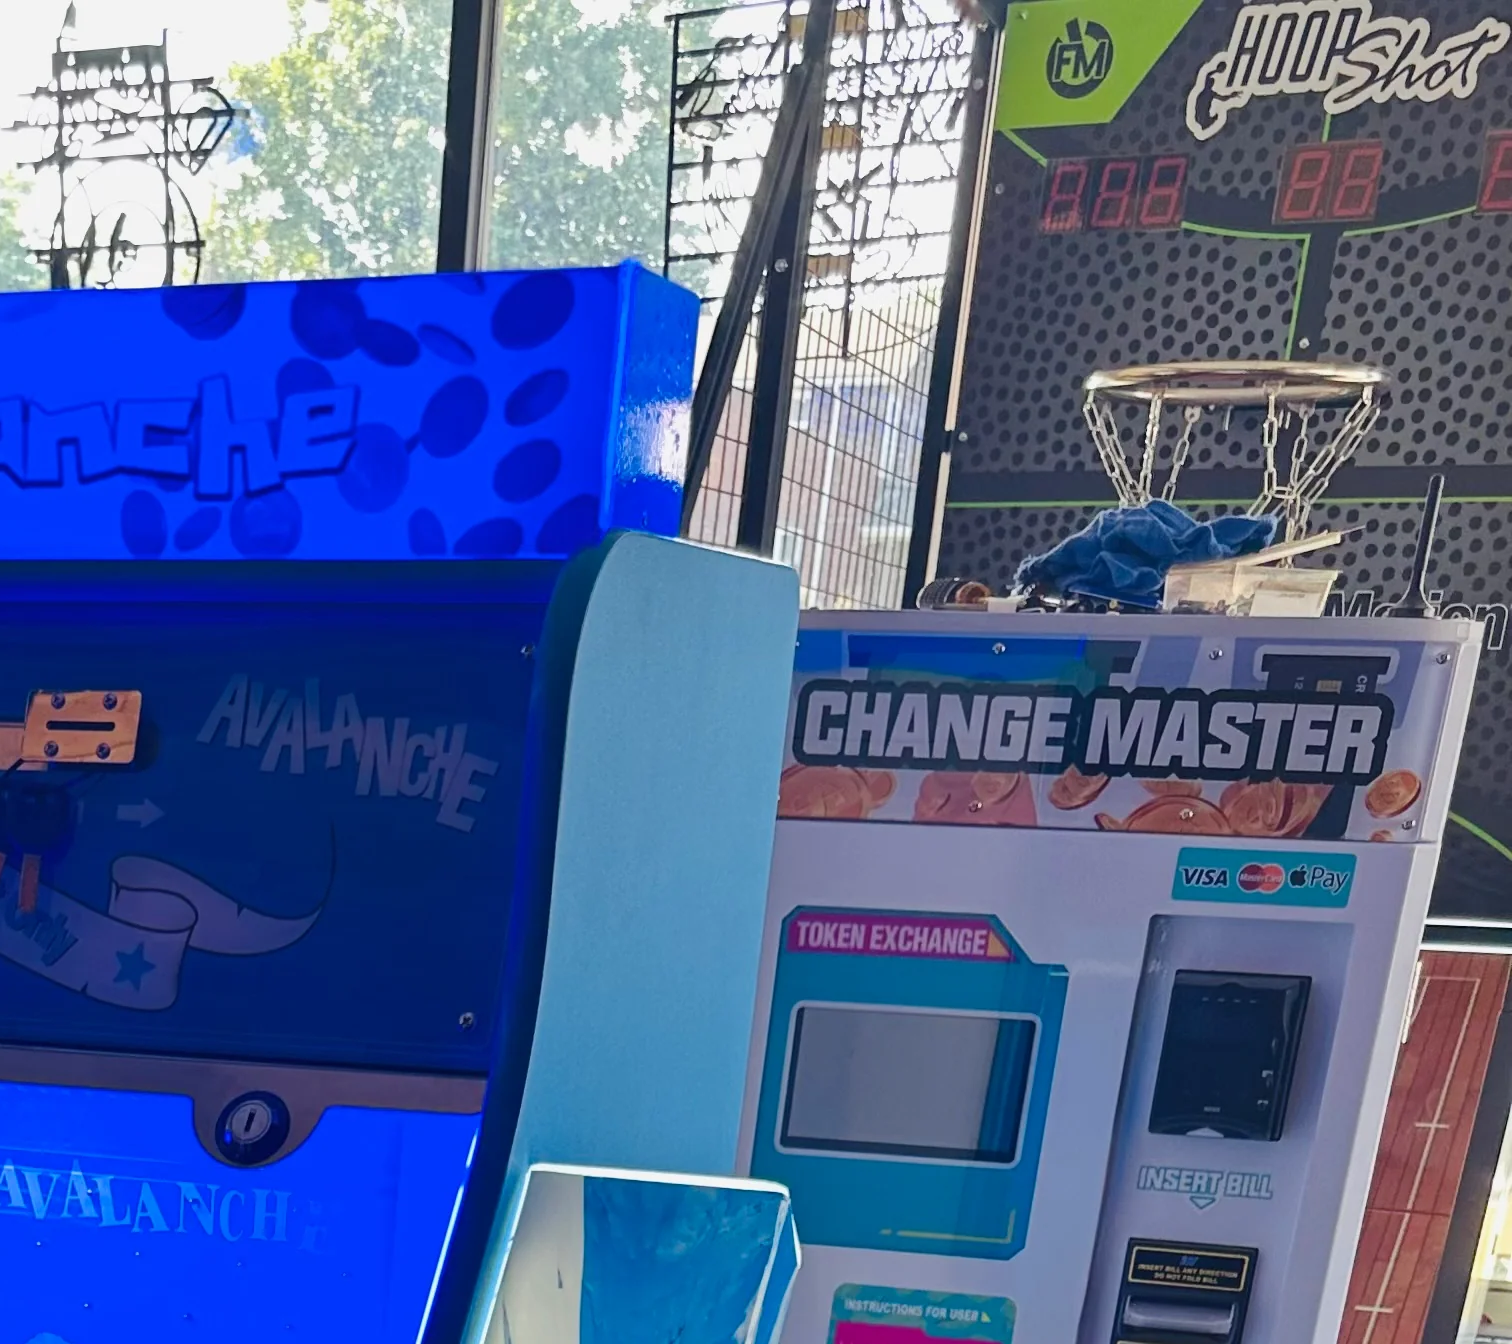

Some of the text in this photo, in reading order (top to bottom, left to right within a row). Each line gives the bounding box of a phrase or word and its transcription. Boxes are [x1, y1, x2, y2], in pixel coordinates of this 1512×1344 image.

[1051, 38, 1109, 84] FM
[801, 689, 1384, 776] CHANGE MASTER
[195, 672, 500, 834] AVALANCHE
[1182, 867, 1229, 887] VISA
[1310, 866, 1349, 894] Pay
[796, 920, 989, 957] TOKEN EXCHANGE
[1137, 1165, 1274, 1201] INSERT BILL
[844, 1299, 980, 1322] INSTRUCTIONS FOR USER
